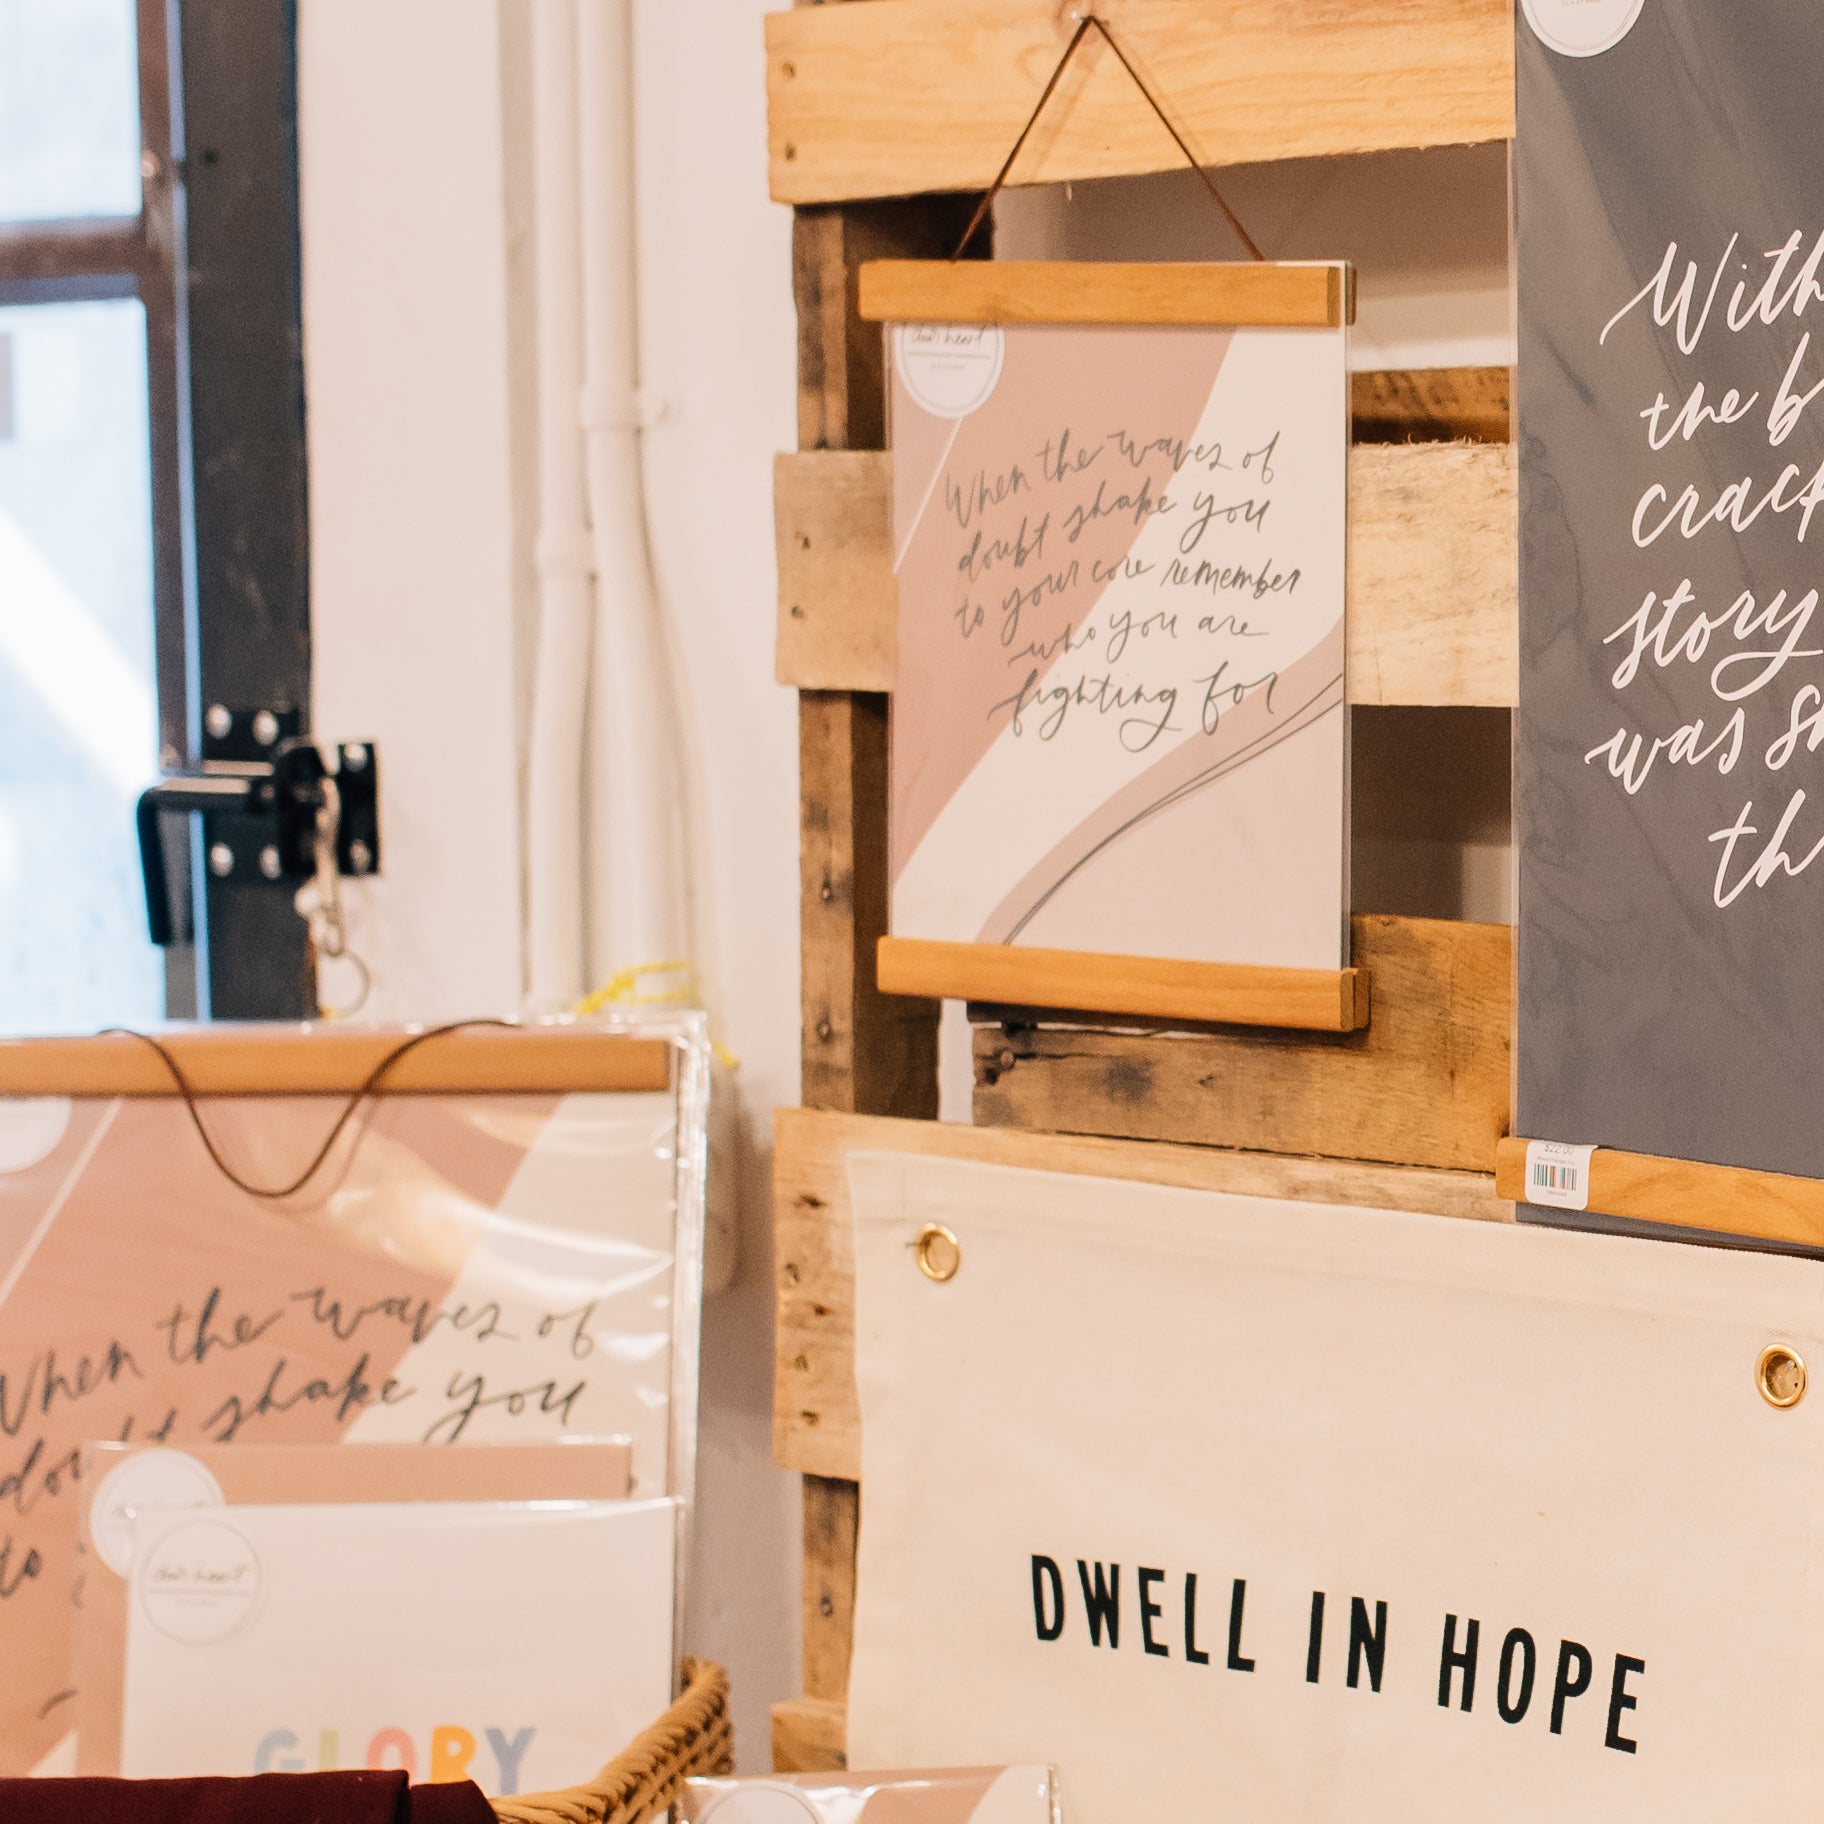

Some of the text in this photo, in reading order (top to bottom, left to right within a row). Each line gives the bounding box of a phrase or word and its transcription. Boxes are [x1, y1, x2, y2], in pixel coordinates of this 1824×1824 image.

[1639, 381, 1759, 451] the
[945, 428, 1281, 529] When the waves of
[957, 476, 1271, 584] doubt shake you
[954, 554, 1302, 646] to your core remember
[1007, 608, 1269, 666] who you are
[1602, 578, 1824, 701] story
[986, 659, 1280, 753] fighting for
[1584, 707, 1746, 794] was
[154, 1286, 285, 1364] the
[289, 1285, 519, 1345] waves
[535, 1299, 600, 1362] of
[200, 1352, 418, 1444] shake
[1031, 1553, 1646, 1755] DWELL IN HOPE
